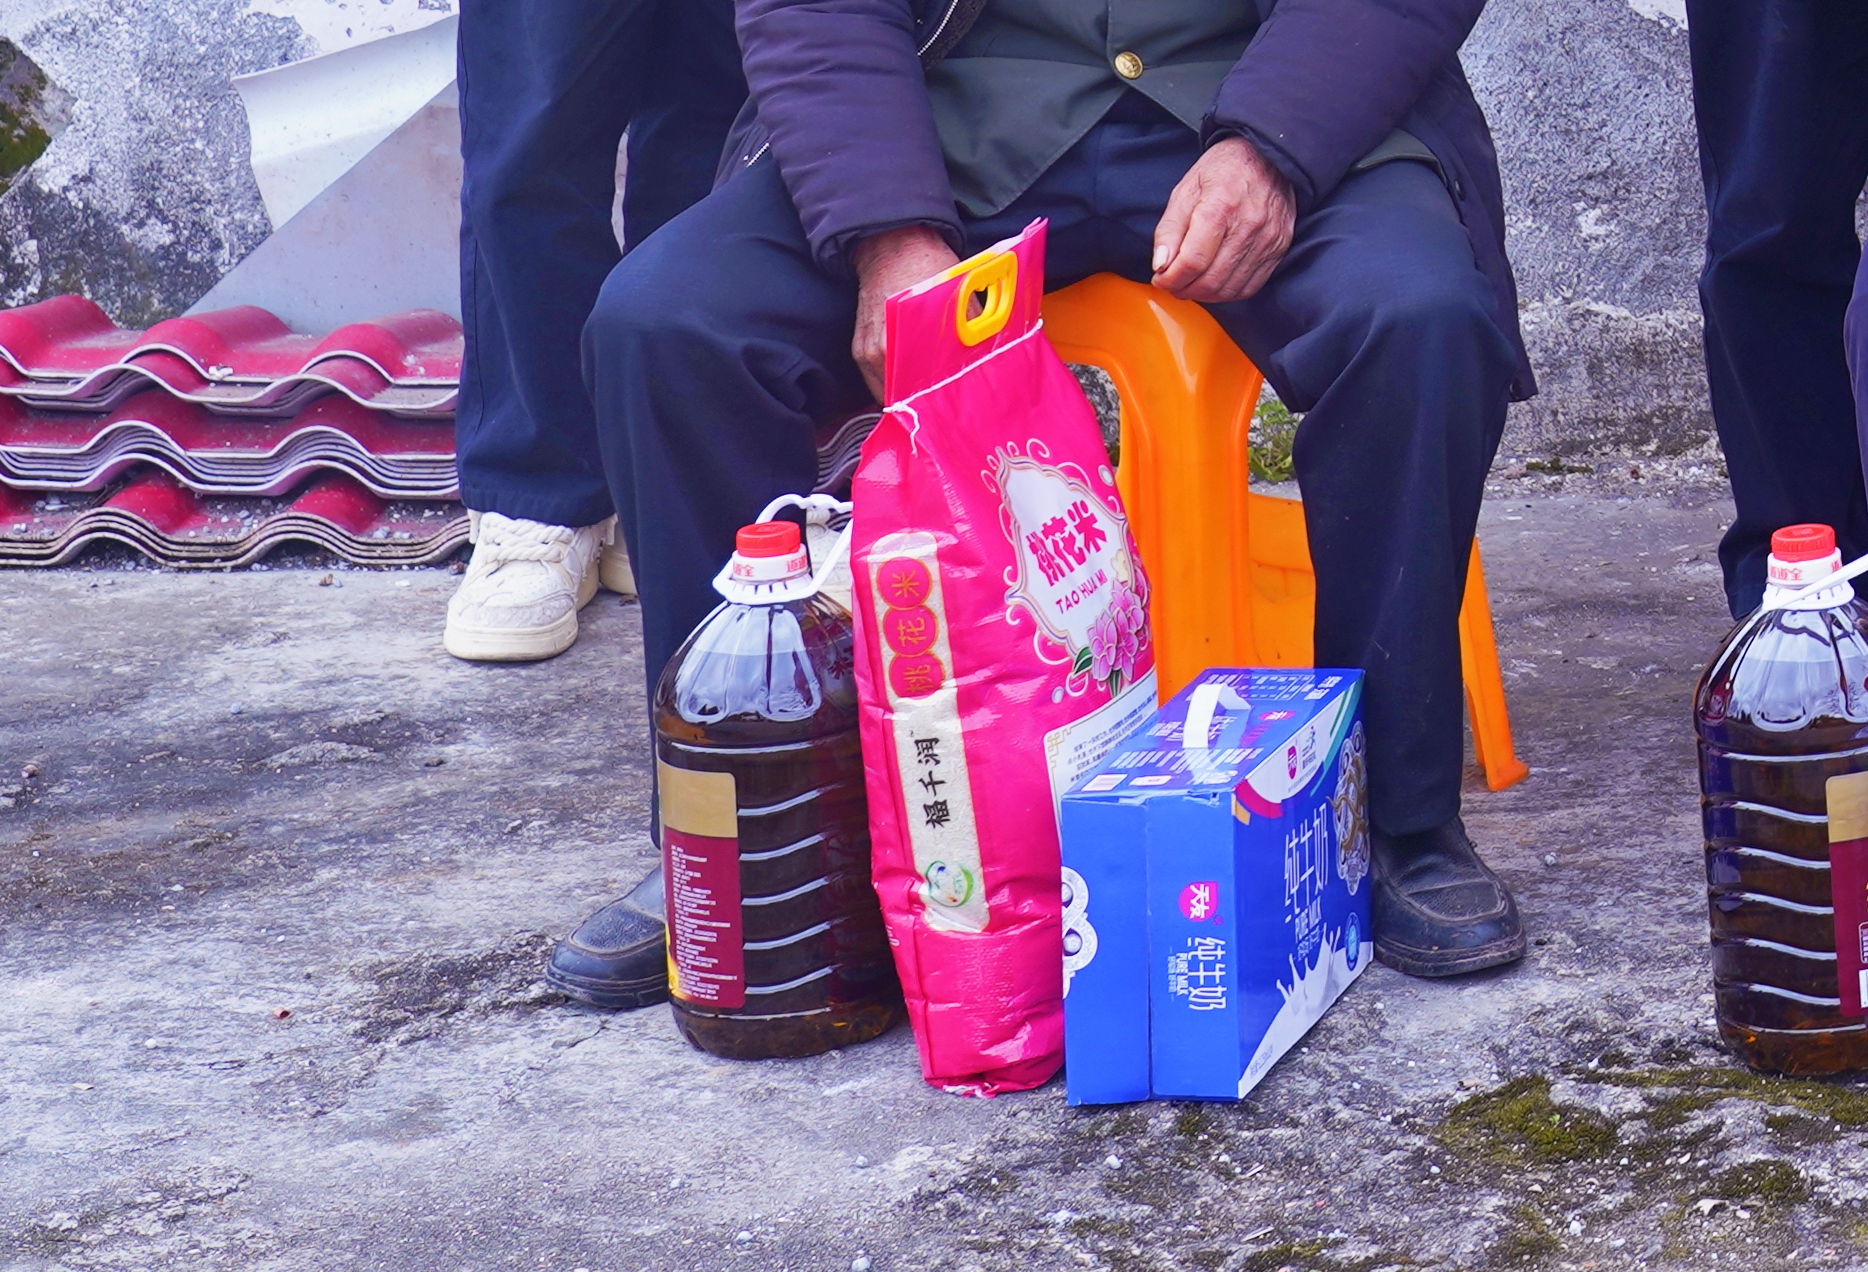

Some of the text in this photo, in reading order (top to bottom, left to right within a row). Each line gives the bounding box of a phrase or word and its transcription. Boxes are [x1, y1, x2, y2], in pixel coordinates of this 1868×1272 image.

[1026, 500, 1107, 587] 桃花米
[1056, 591, 1080, 614] TAO
[913, 736, 950, 830] 福千润
[1186, 936, 1228, 1011] 纯牛奶
